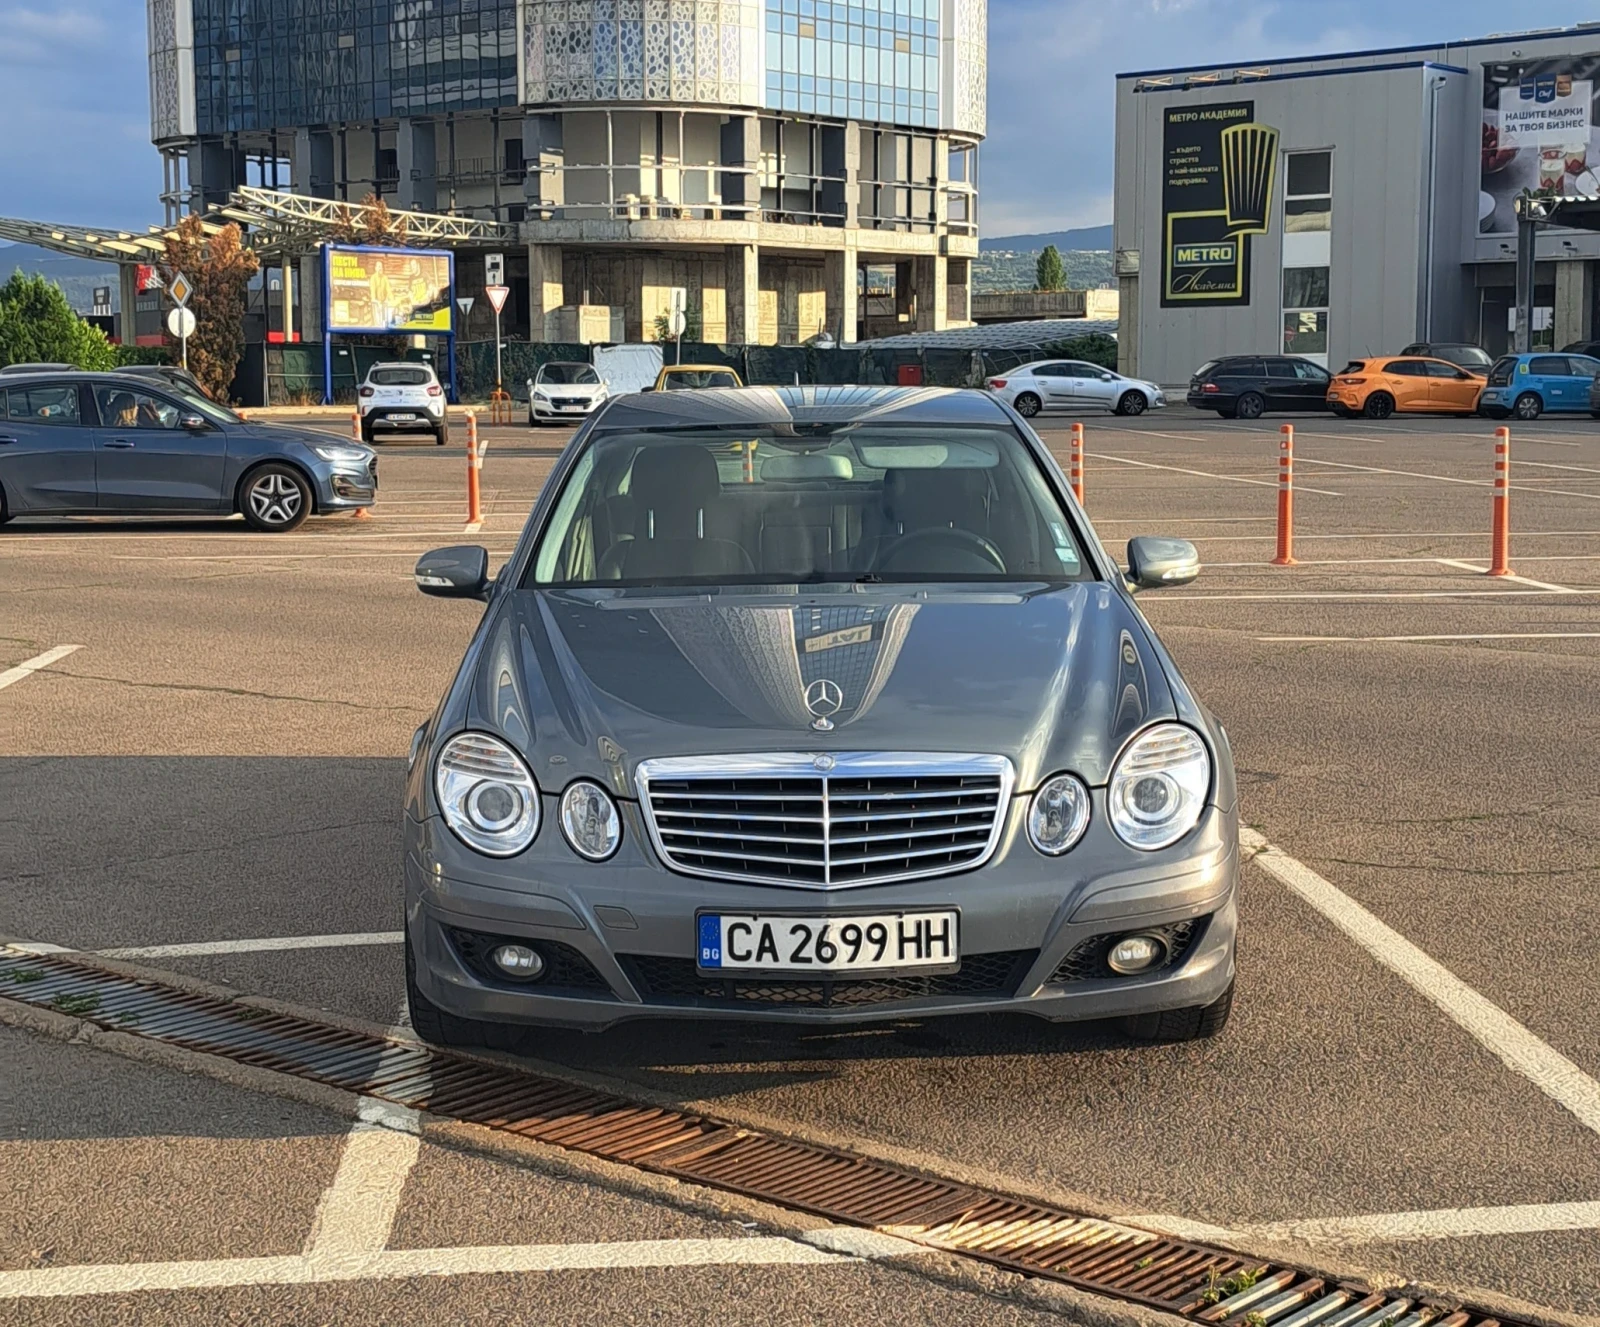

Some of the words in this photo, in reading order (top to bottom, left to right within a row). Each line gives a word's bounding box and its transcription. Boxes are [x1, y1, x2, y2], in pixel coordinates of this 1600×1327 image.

[1169, 112, 1198, 123] МЕТРО
[1199, 108, 1248, 120] АКАДЕМИЯ
[1505, 111, 1547, 121] НАШИТЕ
[1548, 108, 1583, 118] МАРКИ
[1504, 124, 1517, 133] ЗА
[1519, 122, 1544, 132] ТВОЯ
[1546, 119, 1584, 130] БИЗНЕС
[1169, 156, 1199, 165] страстта
[1177, 247, 1232, 262] METRO
[1171, 267, 1236, 293] Академия
[727, 921, 780, 963] CA
[789, 921, 889, 964] 2699
[897, 918, 950, 961] HH
[702, 948, 719, 960] BG
